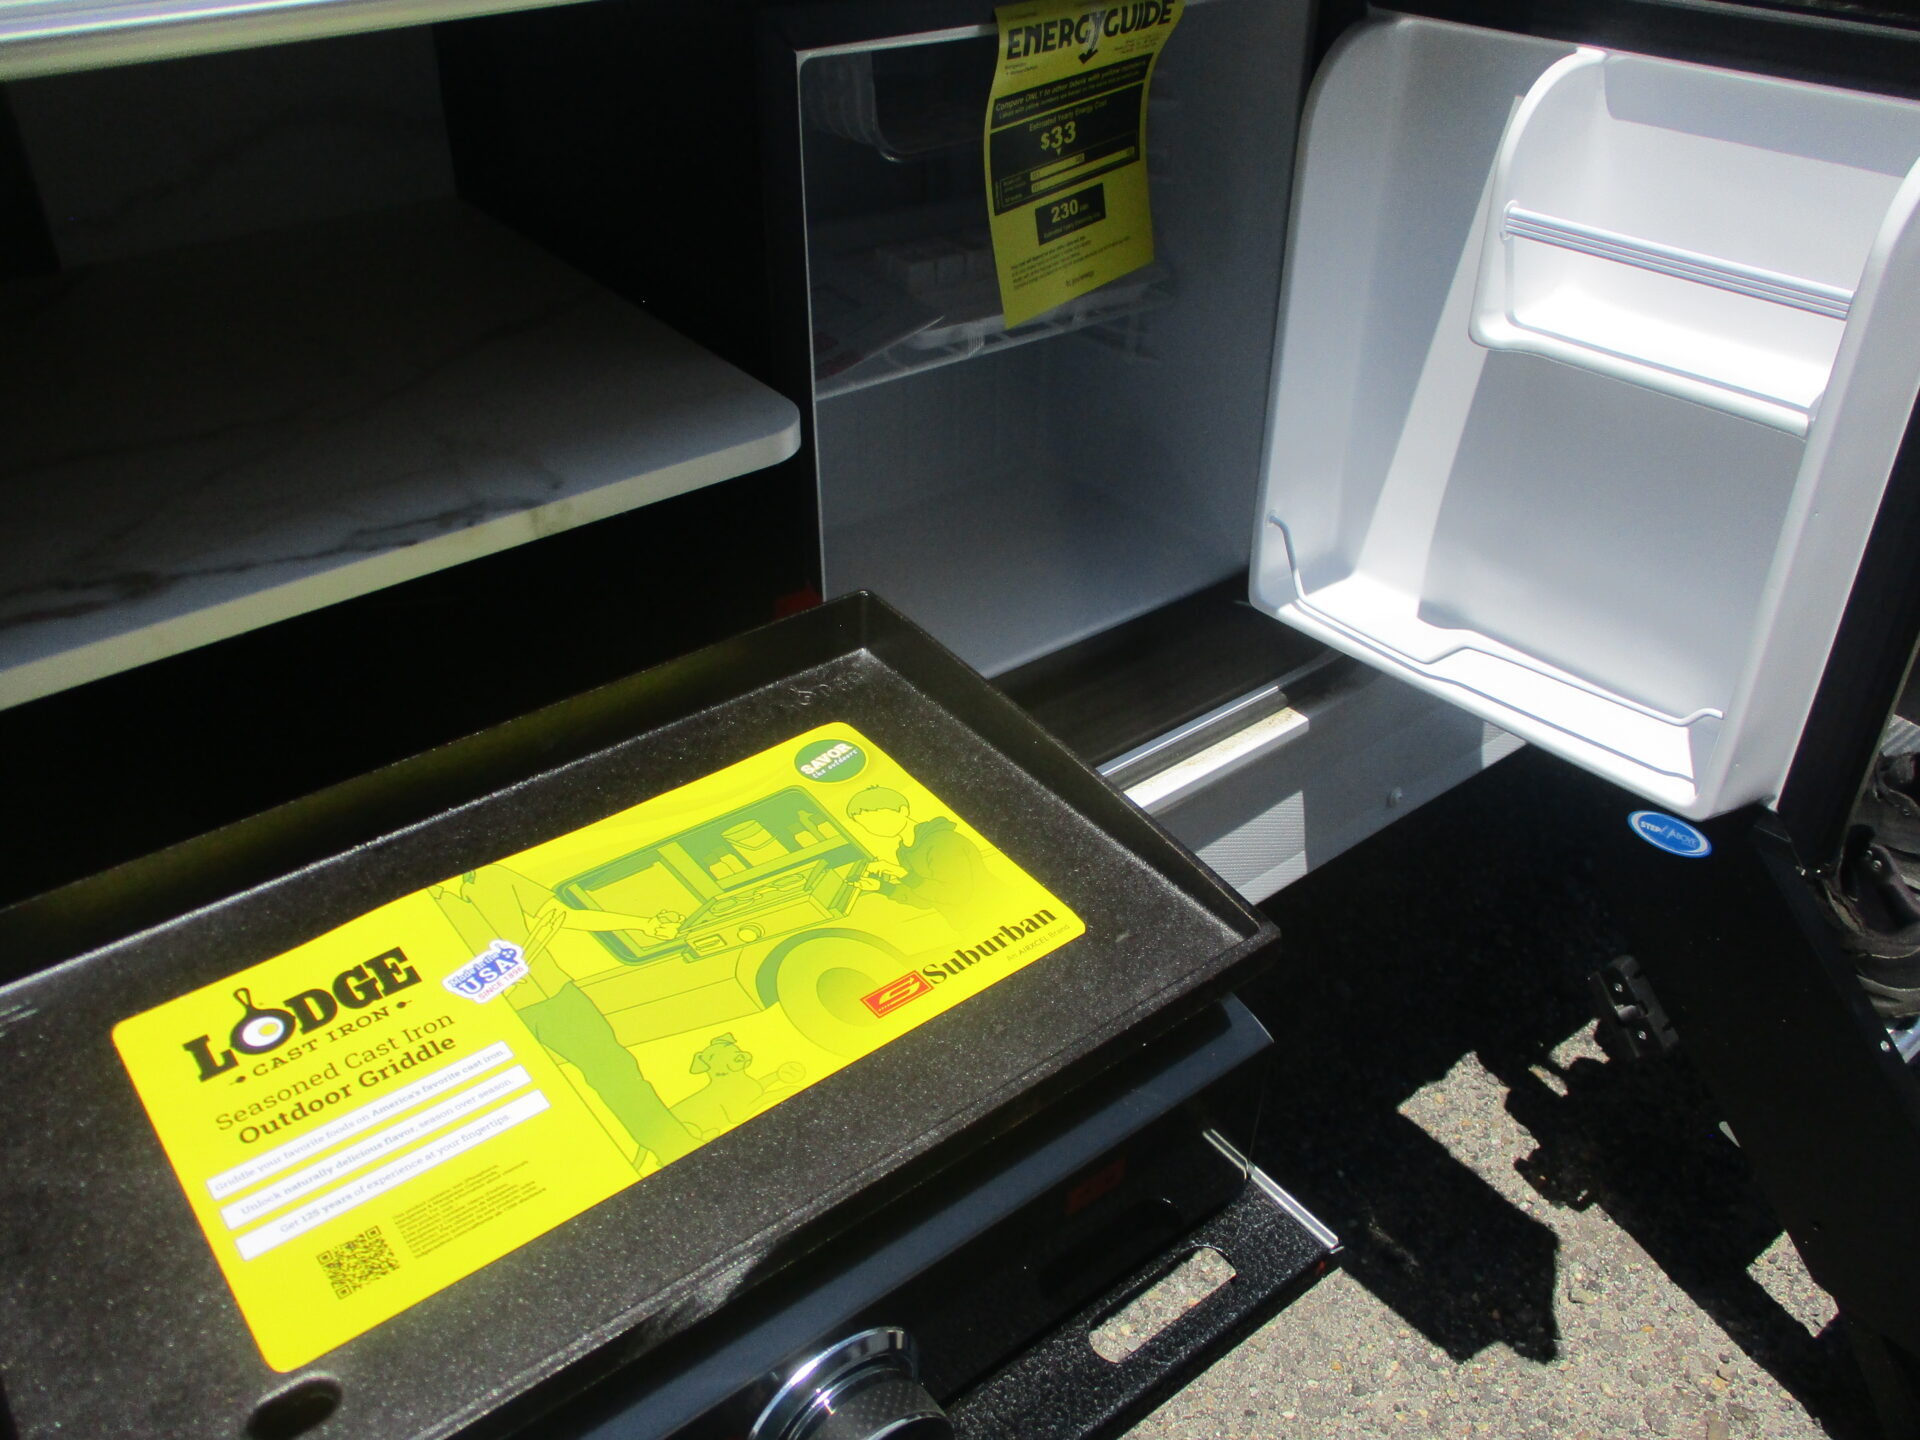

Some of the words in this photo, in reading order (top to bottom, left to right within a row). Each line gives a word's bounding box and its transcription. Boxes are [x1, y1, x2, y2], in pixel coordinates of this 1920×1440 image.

[1040, 120, 1077, 150] $33
[1051, 199, 1079, 223] 230
[800, 743, 854, 774] SAVOR
[456, 958, 519, 994] USA
[921, 908, 1058, 985] Suburban
[478, 981, 503, 1000] SINCE
[215, 1062, 341, 1131] Seasoned
[344, 1036, 400, 1070] Cast
[402, 1013, 456, 1044] Iron
[252, 1038, 319, 1078] CAST
[327, 1006, 391, 1044] IRON
[238, 1083, 353, 1145] Outdoor
[357, 1037, 457, 1088] Griddle
[372, 1089, 421, 1117] America's
[422, 1069, 461, 1093] favorite
[462, 1059, 482, 1073] cast
[241, 1191, 282, 1215] Unlock
[283, 1166, 334, 1195] naturally
[336, 1142, 384, 1169] delicious
[419, 1107, 454, 1128] season
[455, 1096, 477, 1111] over
[280, 1218, 299, 1233] Get
[321, 1193, 353, 1213] years
[354, 1185, 367, 1197] of
[367, 1156, 424, 1191] experience
[425, 1150, 437, 1161] at
[437, 1138, 461, 1157] your
